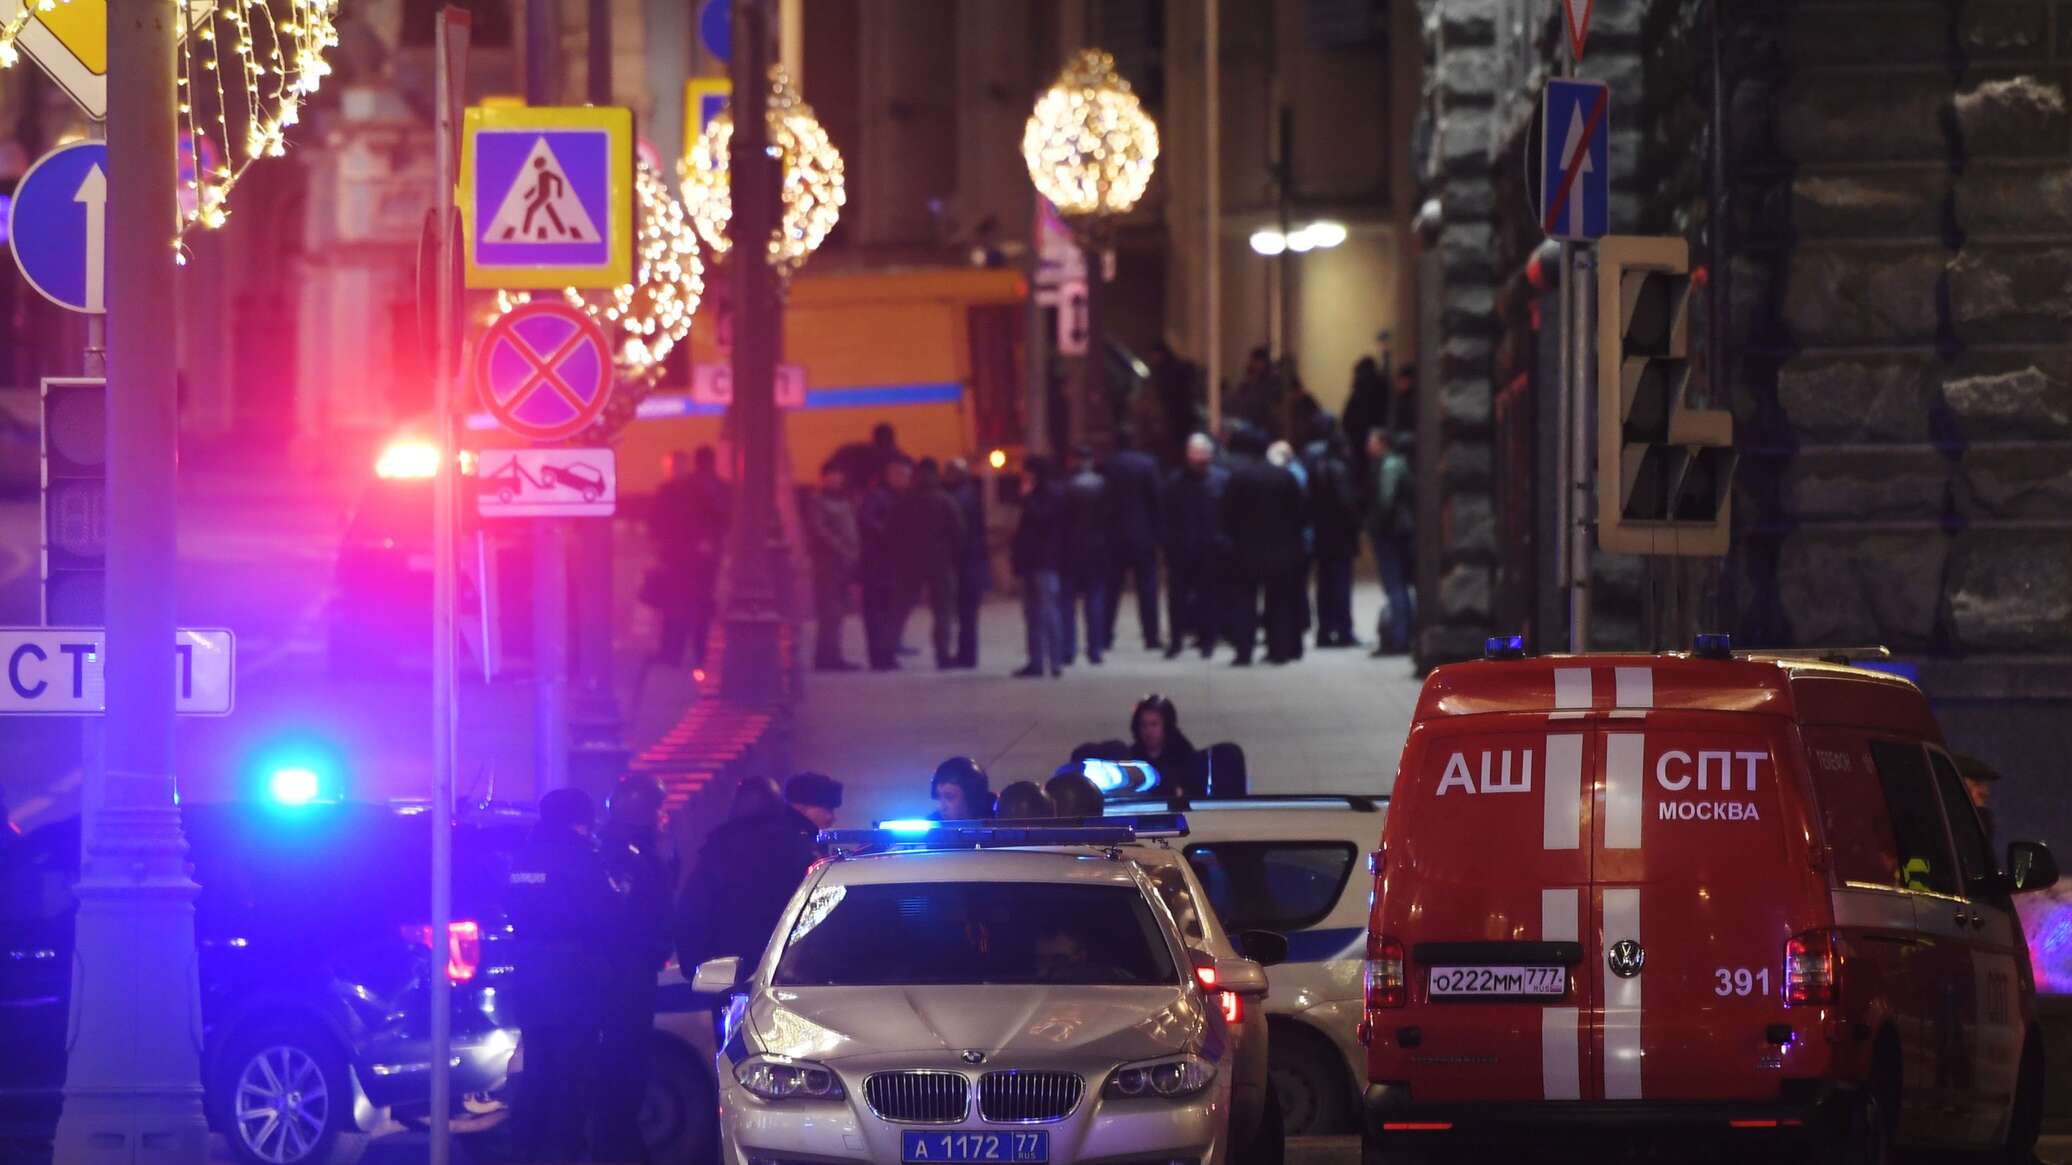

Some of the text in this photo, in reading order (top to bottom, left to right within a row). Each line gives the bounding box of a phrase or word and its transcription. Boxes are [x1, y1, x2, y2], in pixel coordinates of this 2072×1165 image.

[1436, 749, 1768, 796] АШ СПТ
[1658, 802, 1760, 821] МОСКВА
[1527, 969, 1559, 985] 777
[1715, 968, 1769, 996] 391
[941, 1136, 999, 1159] 1172
[1016, 1134, 1039, 1151] 77
